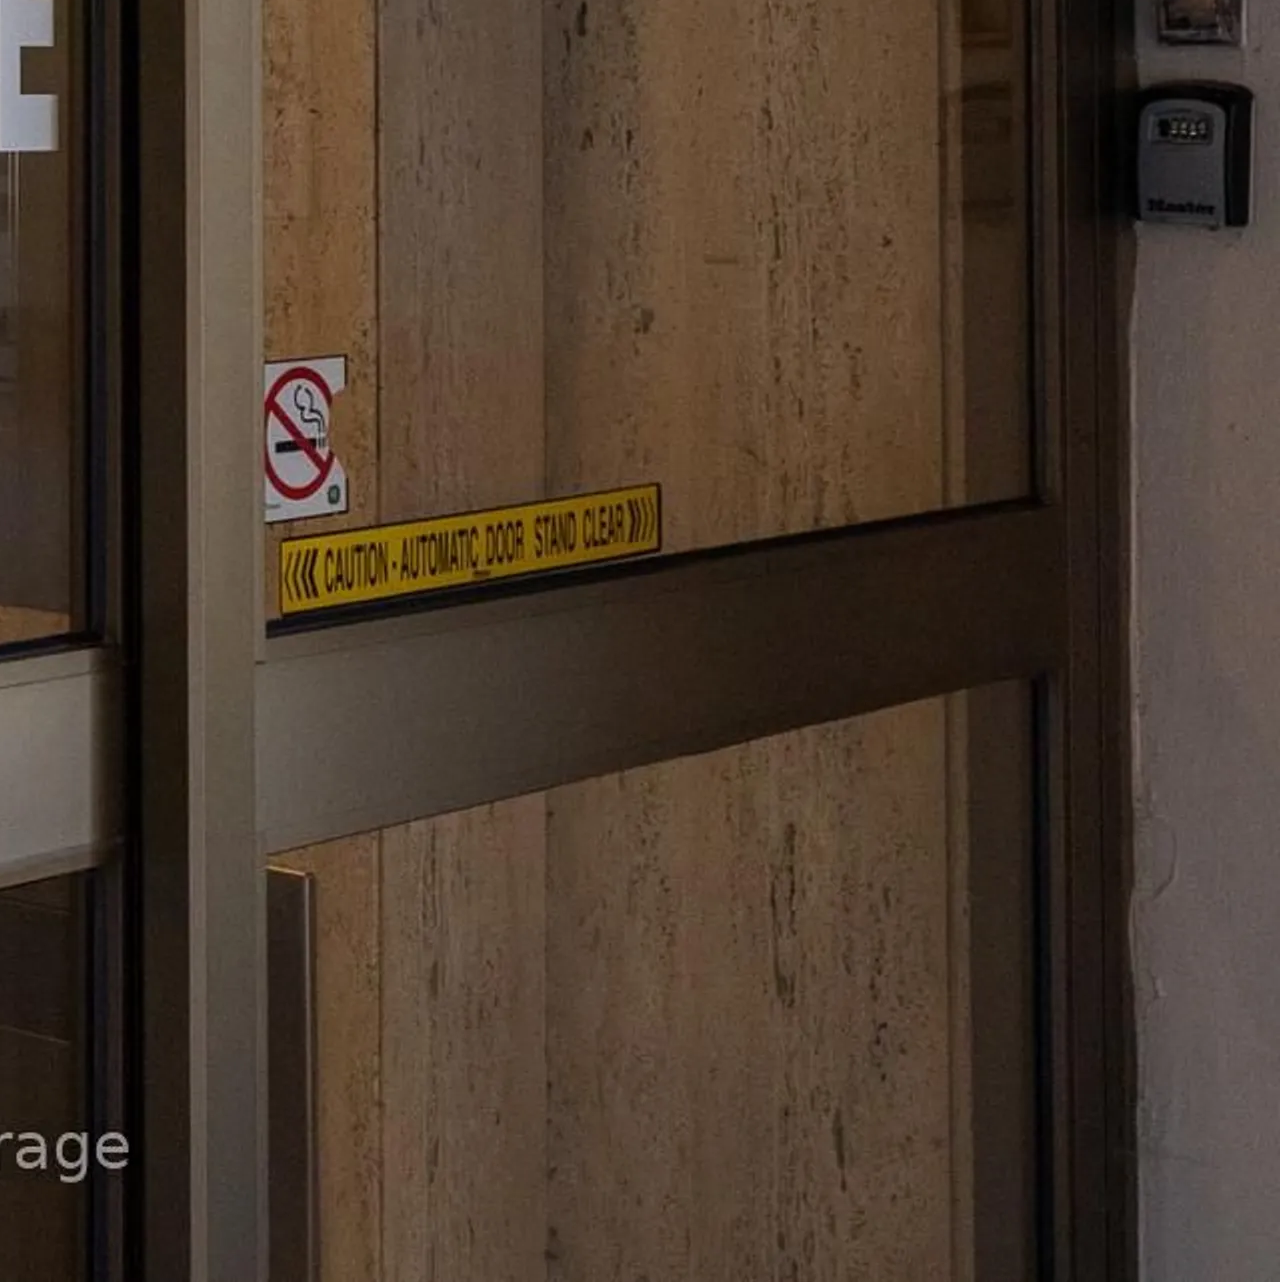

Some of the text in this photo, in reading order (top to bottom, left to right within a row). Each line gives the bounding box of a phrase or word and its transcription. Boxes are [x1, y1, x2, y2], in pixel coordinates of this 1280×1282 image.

[324, 543, 390, 592] CAUTION
[400, 527, 480, 579] AUTOMATIC
[486, 520, 525, 566] DOOR
[535, 511, 577, 558] STAND
[583, 502, 626, 548] CLEAR
